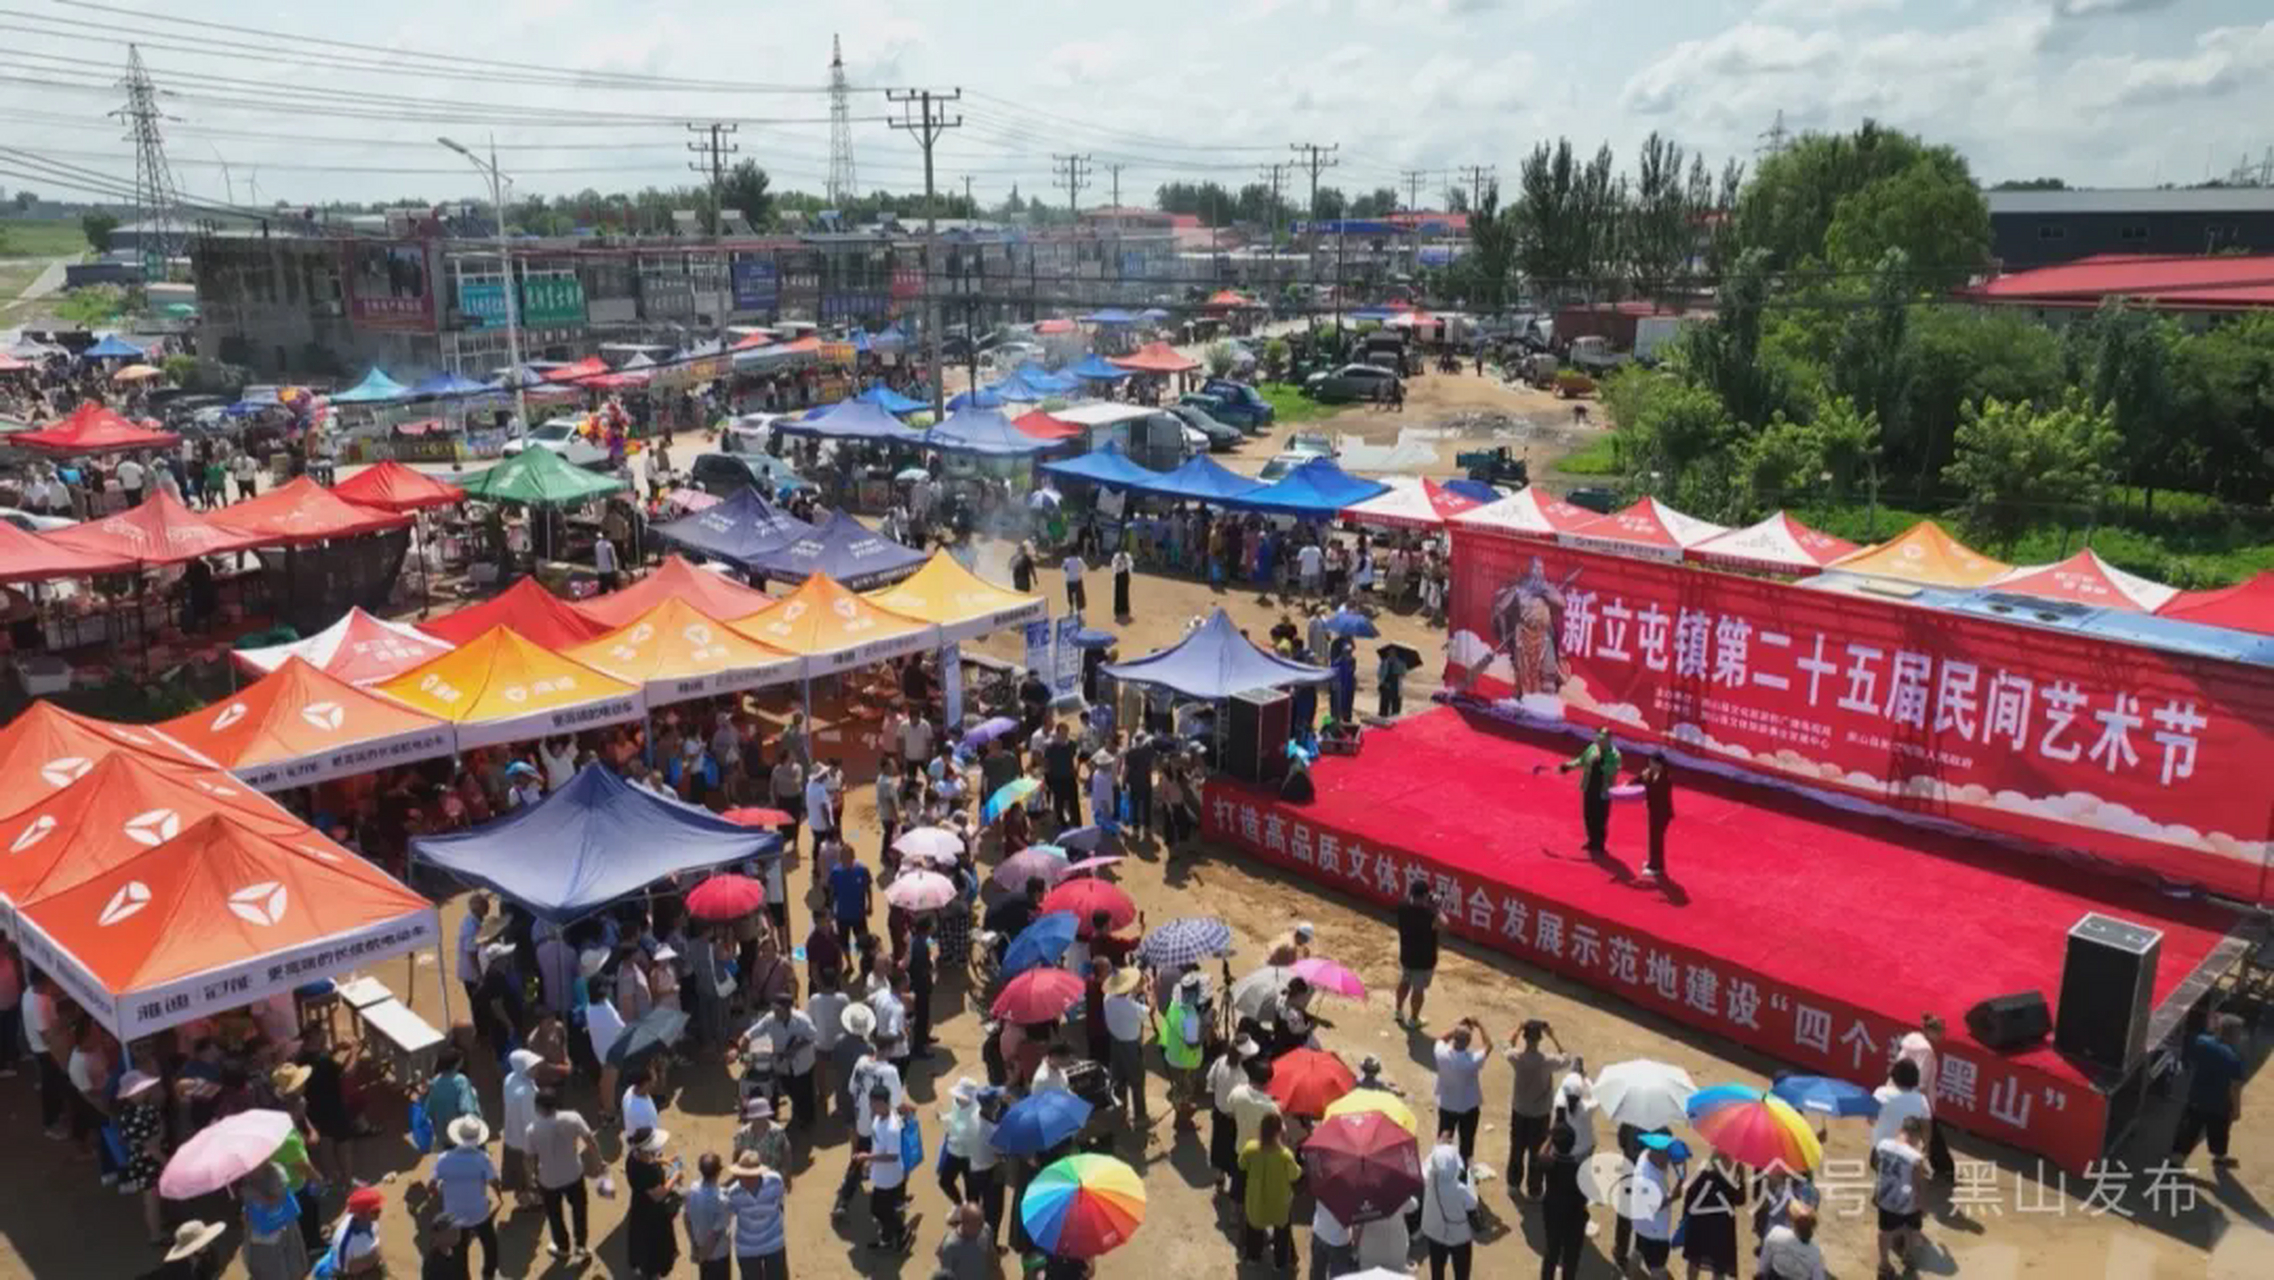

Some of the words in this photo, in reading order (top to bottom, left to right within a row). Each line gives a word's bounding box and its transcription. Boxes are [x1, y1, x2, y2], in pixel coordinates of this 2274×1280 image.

[1562, 588, 2207, 786] 新立屯镇第二十五届民间艺术节
[1212, 796, 2066, 1129] 打造高品质文体融合发展示范地建设“四个黑山”
